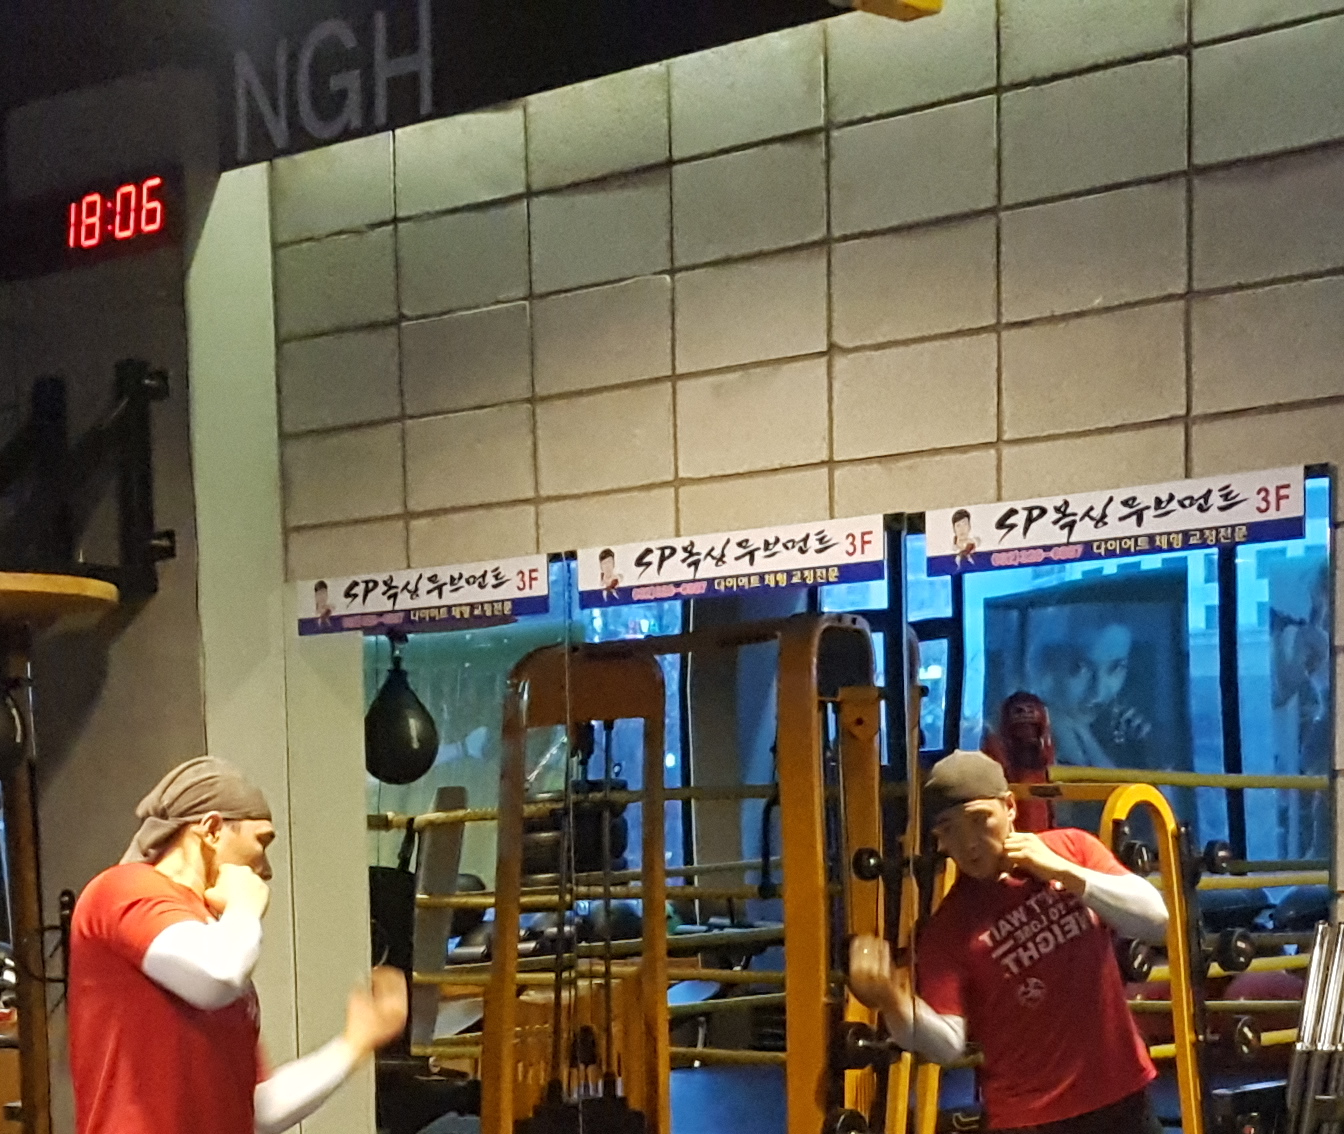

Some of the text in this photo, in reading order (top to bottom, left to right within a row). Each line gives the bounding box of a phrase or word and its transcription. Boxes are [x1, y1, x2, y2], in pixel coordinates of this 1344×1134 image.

[67, 175, 165, 250] 18:06
[1255, 484, 1292, 514] 3F
[845, 530, 874, 557] 3F
[1091, 525, 1248, 555] 다이어트 체형 교정전문
[516, 568, 539, 592] 3F
[714, 575, 760, 592] 다이어트
[764, 572, 787, 588] 체형
[790, 566, 840, 585] 교정전문
